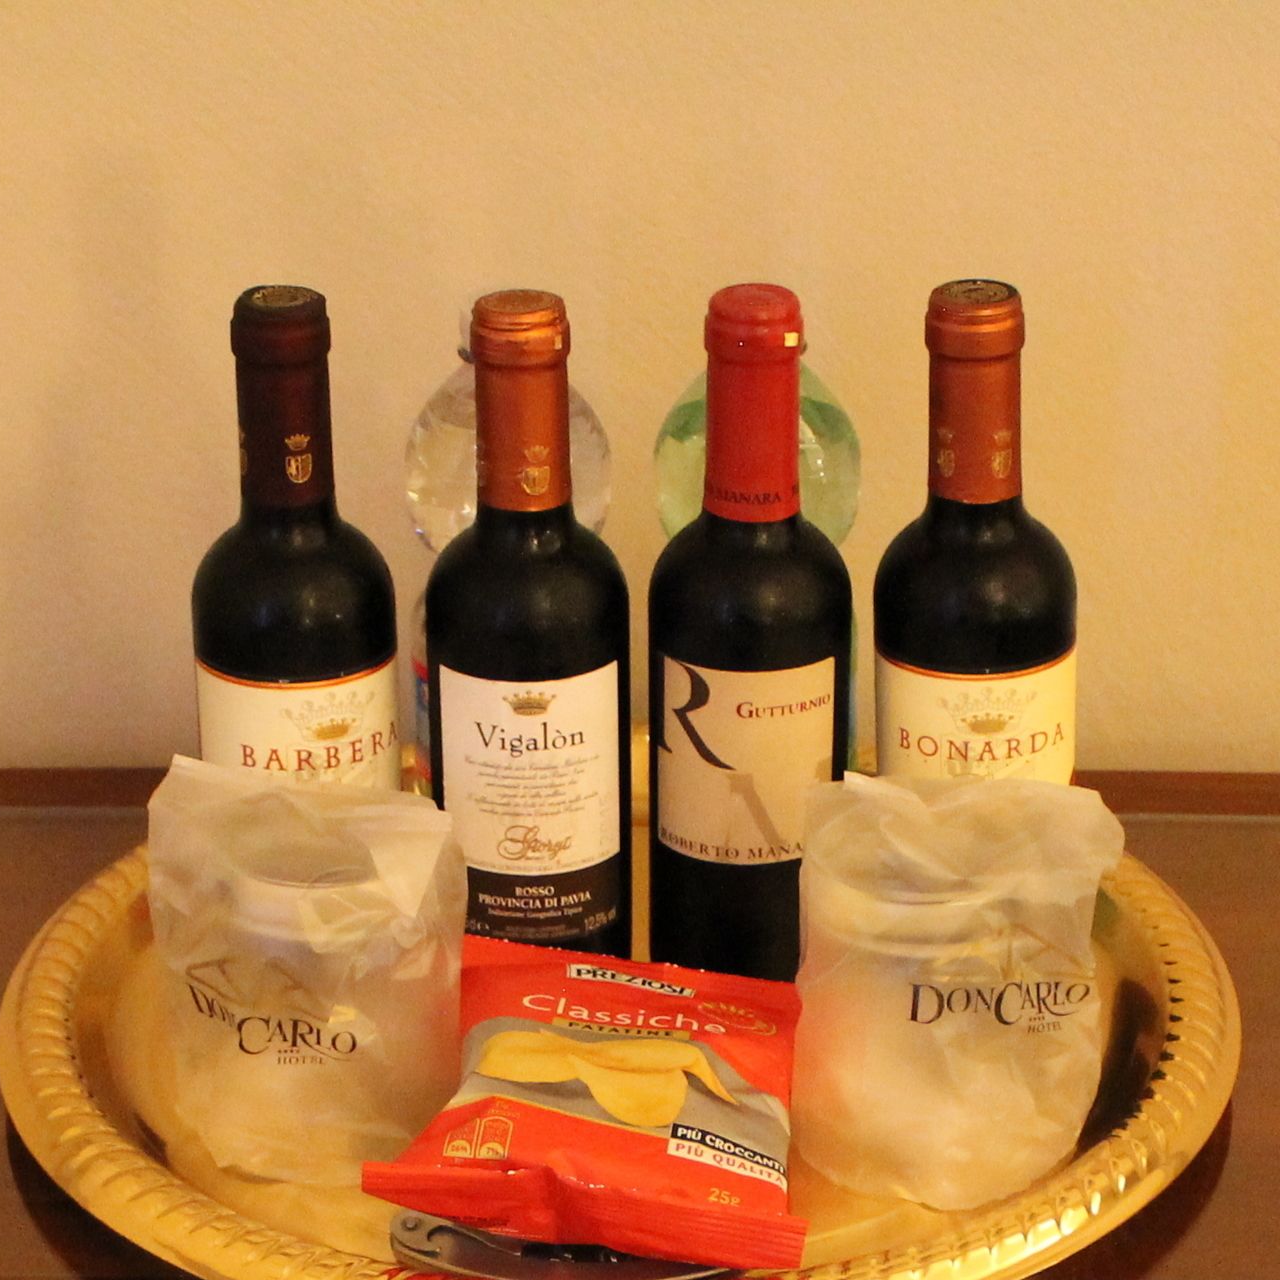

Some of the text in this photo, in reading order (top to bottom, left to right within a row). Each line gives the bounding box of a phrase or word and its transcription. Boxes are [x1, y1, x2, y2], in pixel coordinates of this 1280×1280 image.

[240, 721, 399, 772] BARBERA
[474, 721, 586, 758] Vigalòn
[899, 722, 1065, 762] BONARDA
[661, 827, 739, 858] ROBERTO
[478, 890, 592, 909] PROVINCIA DI PAVIA
[515, 886, 555, 897] ROSSO
[575, 967, 686, 997] PREZIOSI
[522, 994, 726, 1034] Classiche
[568, 1022, 674, 1037] PATATINE
[1027, 1020, 1062, 1033] HOTEL
[237, 1016, 358, 1063] CARLO
[674, 1142, 704, 1158] PIÙ
[676, 1126, 785, 1174] PIÙ CROCCANTI
